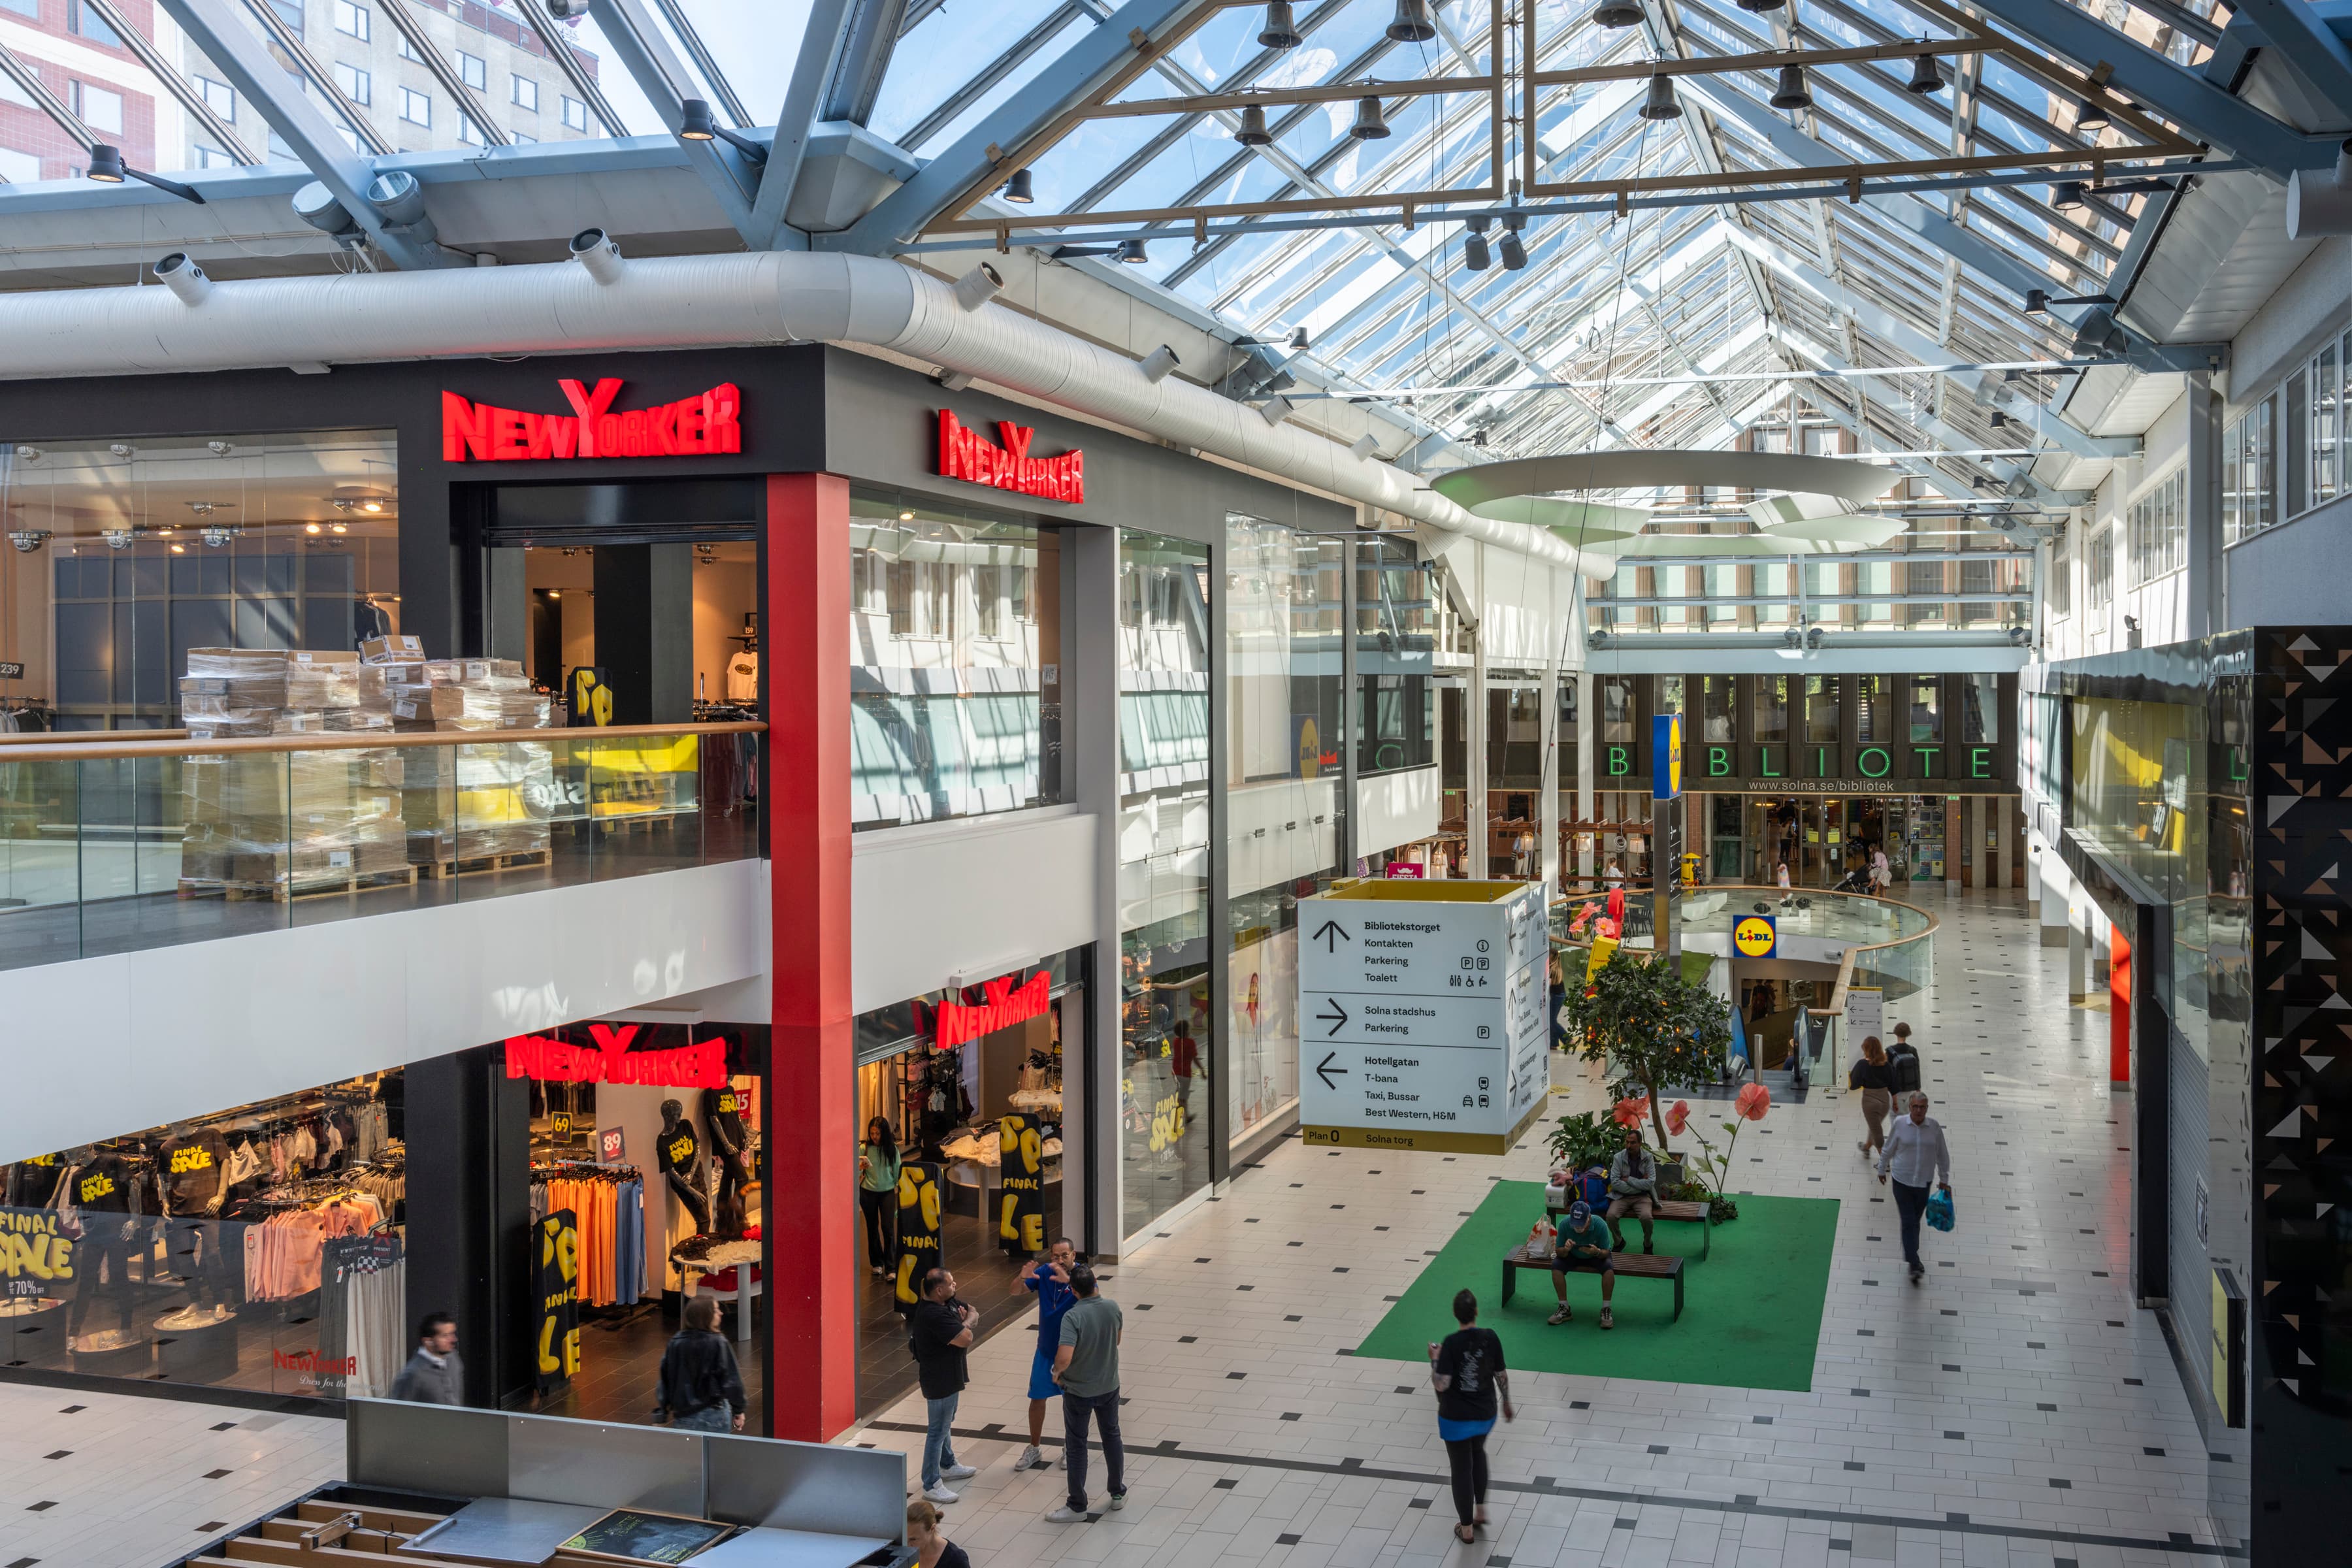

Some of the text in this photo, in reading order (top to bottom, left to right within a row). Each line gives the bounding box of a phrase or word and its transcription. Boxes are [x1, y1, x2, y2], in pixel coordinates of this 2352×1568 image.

[1, 664, 19, 674] 239
[1748, 780, 1894, 792] www.solna.se/bibliotek
[1364, 921, 1441, 934] Bibliotekstorget
[1364, 938, 1413, 948] Kontakten
[1365, 956, 1409, 968] Parkering
[1365, 973, 1398, 983] Toalett
[1365, 1005, 1436, 1017] Solna stadshus
[1365, 1023, 1409, 1035] Parkering
[1365, 1056, 1419, 1068] Hotellgatan
[1365, 1073, 1398, 1083] T-bana
[1365, 1090, 1420, 1102] Taxi, Bussar
[1155, 1091, 1179, 1117] FINAL
[1365, 1107, 1456, 1121] Best Western, H&M
[555, 1118, 569, 1132] 69
[1150, 1106, 1184, 1152] SALE
[604, 1133, 621, 1151] 89
[1309, 1131, 1328, 1141] Plan
[1365, 1134, 1414, 1147] Solna torg
[669, 1135, 689, 1151] FINAL
[173, 1145, 203, 1156] FINAL
[171, 1152, 211, 1173] SALE
[82, 1172, 104, 1186] FINAL
[1003, 1178, 1039, 1190] FINAL
[82, 1178, 115, 1203] SALE
[15, 1281, 37, 1294] 70%
[299, 1375, 320, 1386] Dress
[320, 1376, 333, 1388] for
[336, 1379, 347, 1388] the
